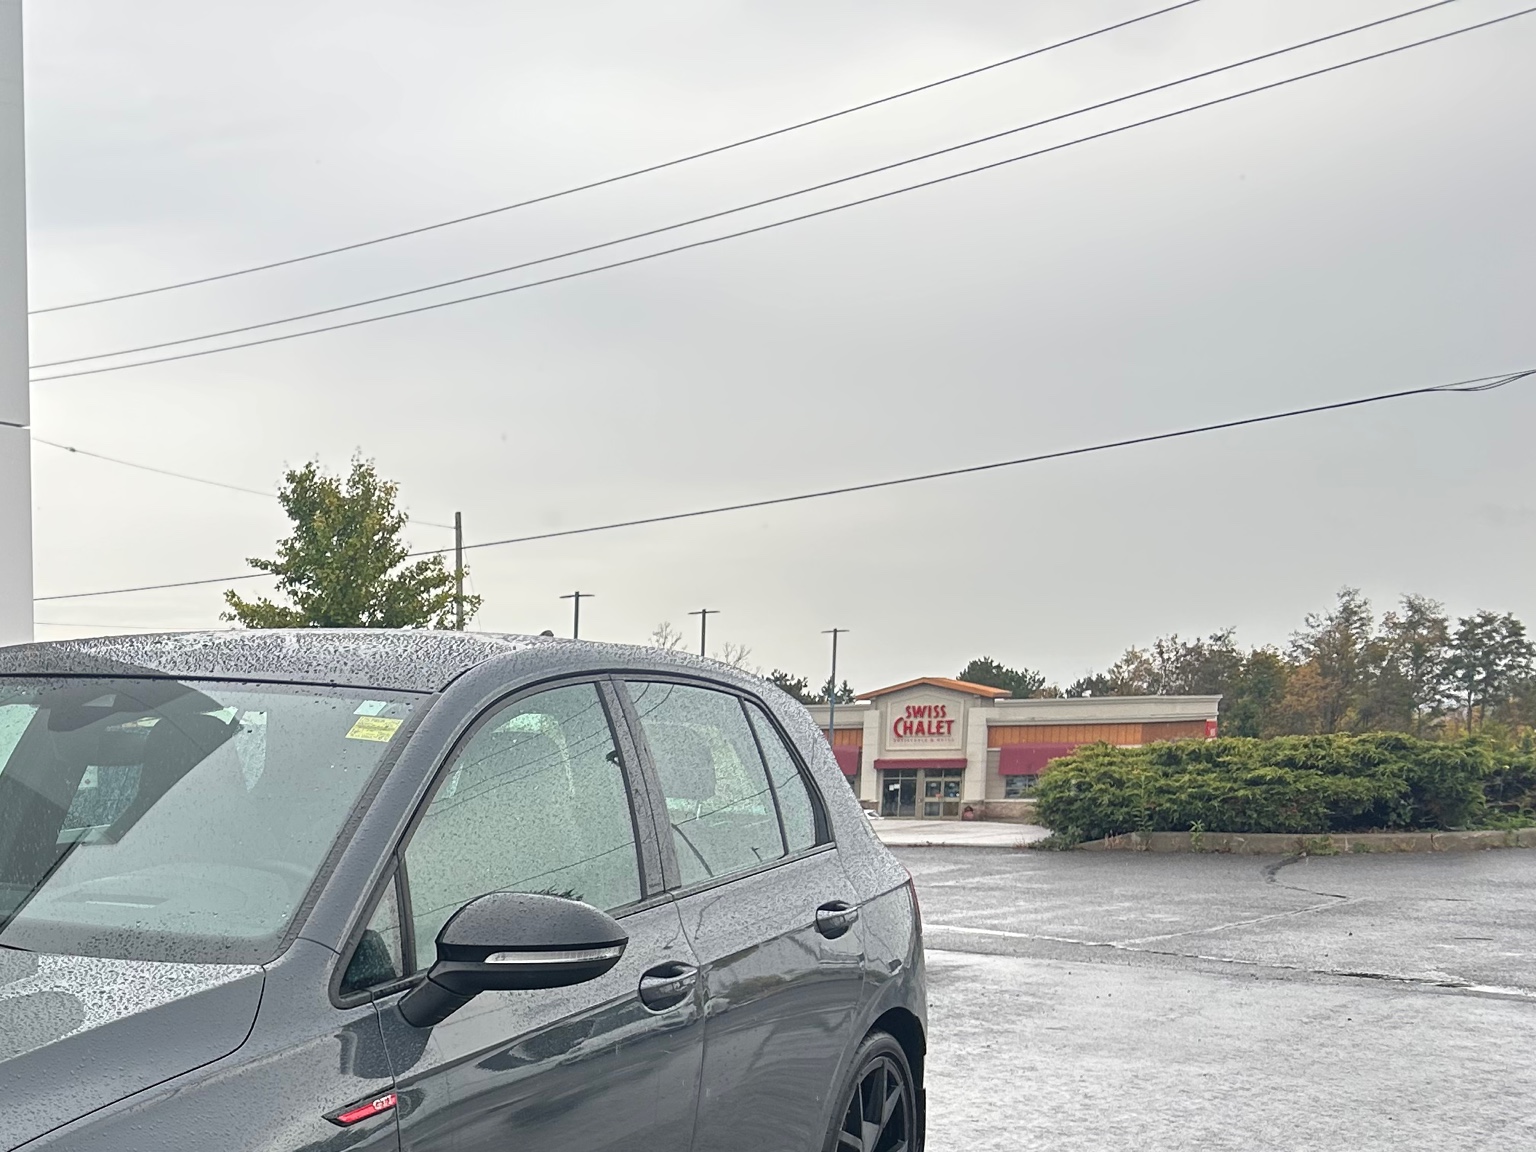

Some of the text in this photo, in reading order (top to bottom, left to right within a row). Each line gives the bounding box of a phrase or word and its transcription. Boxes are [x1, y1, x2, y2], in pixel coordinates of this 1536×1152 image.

[905, 705, 946, 719] SWISS
[893, 717, 955, 738] CHALET
[372, 1094, 393, 1110] GTI
